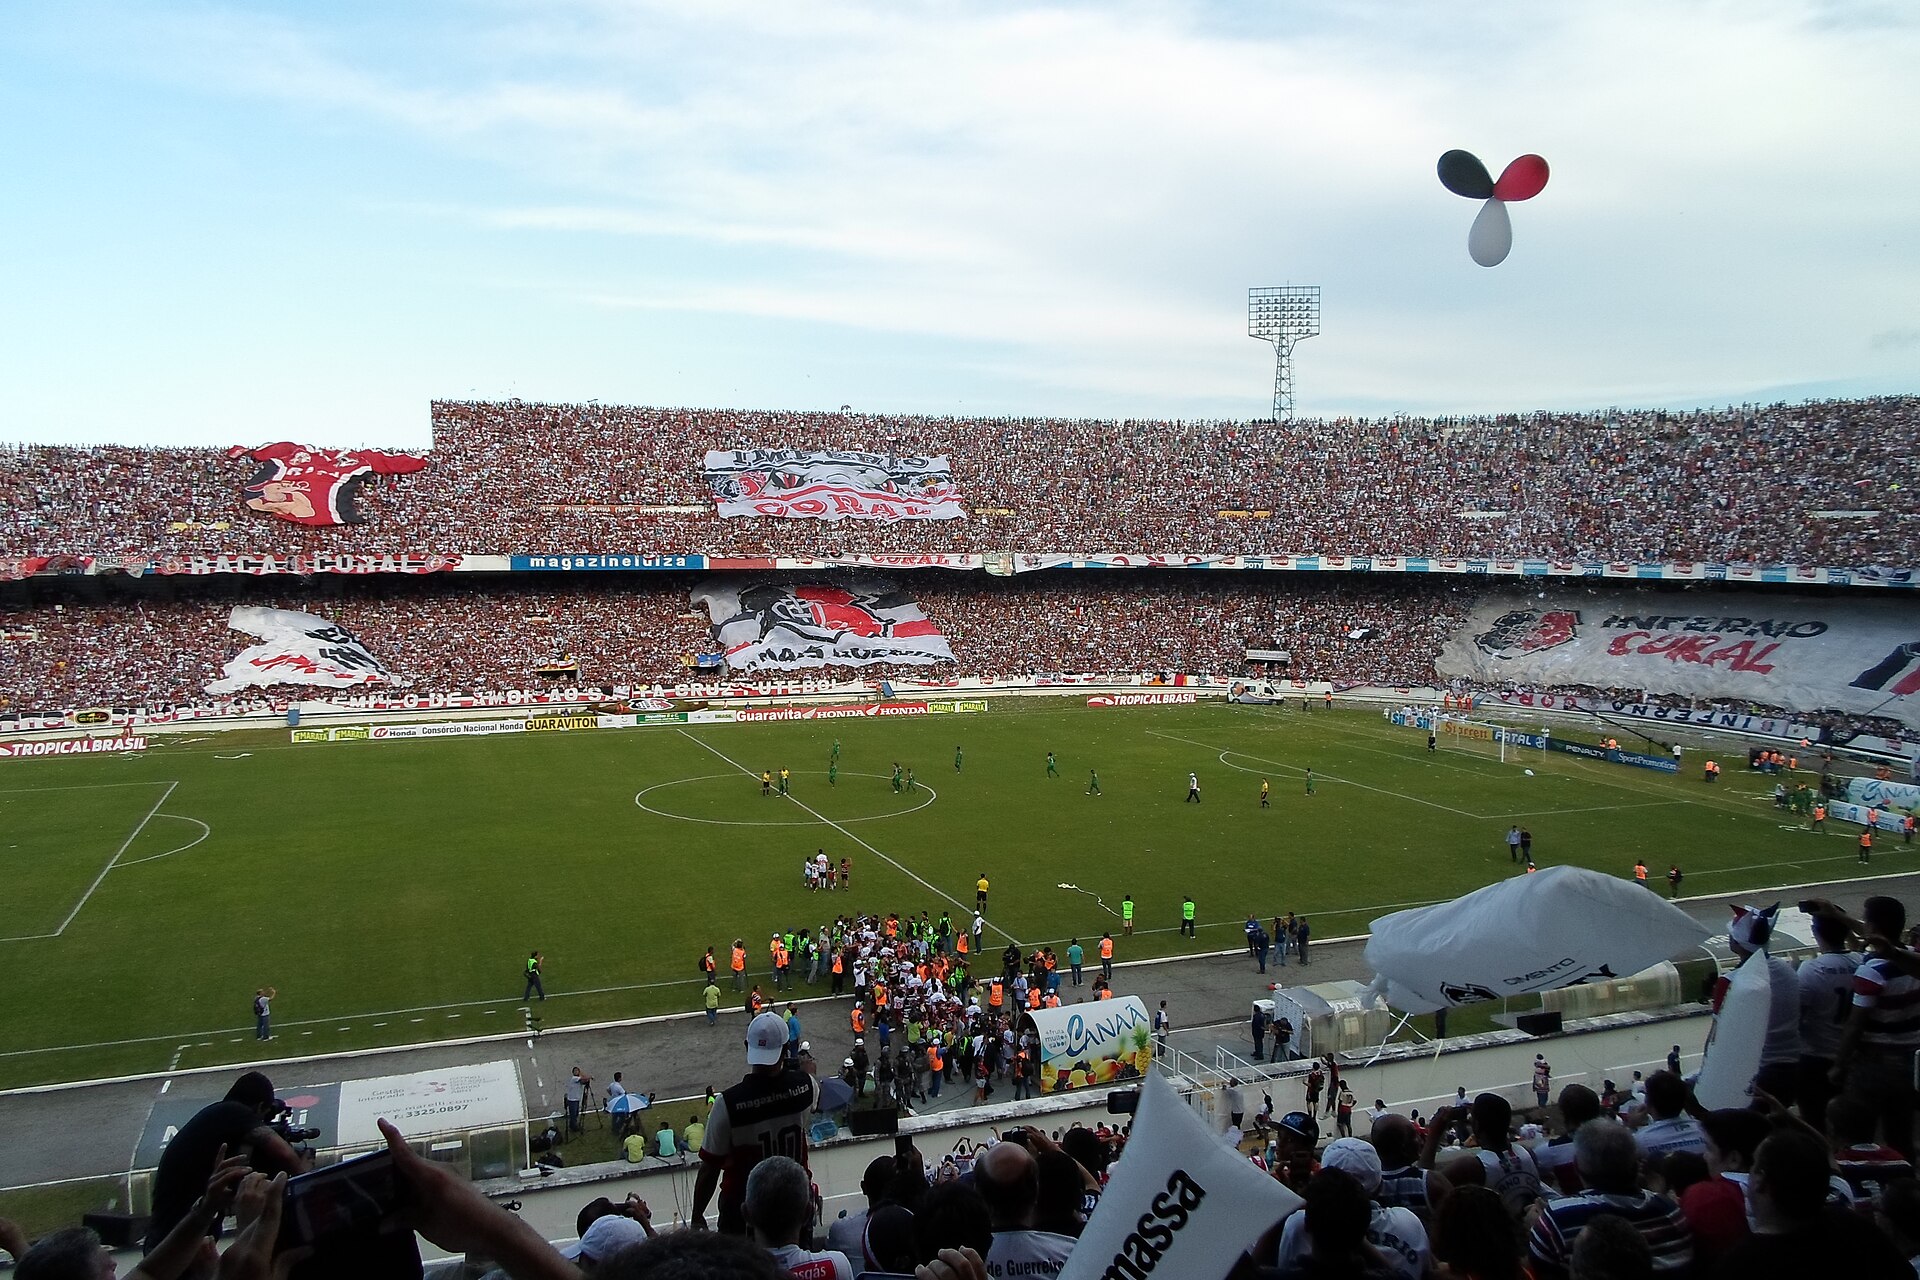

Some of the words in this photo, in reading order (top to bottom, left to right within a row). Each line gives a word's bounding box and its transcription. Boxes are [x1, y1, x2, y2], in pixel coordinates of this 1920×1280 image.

[753, 493, 932, 518] CORAL
[1582, 567, 1602, 575] POTY
[1600, 614, 1829, 638] INFERNO
[1606, 631, 1784, 675] CORAL
[429, 692, 462, 707] DE
[549, 687, 578, 702] AO
[675, 682, 736, 698] CRUZ
[1113, 694, 1163, 706] TROPICAL
[1163, 693, 1197, 704] BRASIL
[736, 709, 801, 722] Guaravita
[816, 709, 866, 719] HONDA
[879, 706, 927, 716] HONDA
[1611, 700, 1752, 729] INFERNO
[422, 726, 461, 735] Consórcio
[463, 724, 498, 732] Nacional
[499, 722, 524, 731] Honda
[524, 717, 598, 731] GUARAVITON
[12, 740, 91, 756] TROPICAL
[91, 737, 148, 751] BRASIL
[1495, 731, 1532, 746] FATAL
[1565, 744, 1605, 758] PENALTY
[1618, 752, 1678, 770] SportPromotion
[1065, 1003, 1148, 1057] CANAÃ
[357, 1092, 405, 1103] Integrada
[372, 1088, 405, 1097] Gestão
[735, 1083, 810, 1111] magazineluiza
[372, 1096, 489, 1116] www.marelli.com.br
[406, 1103, 470, 1119] 3325.0897
[986, 1260, 1002, 1277] de
[1006, 1257, 1065, 1277] Guerreiro
